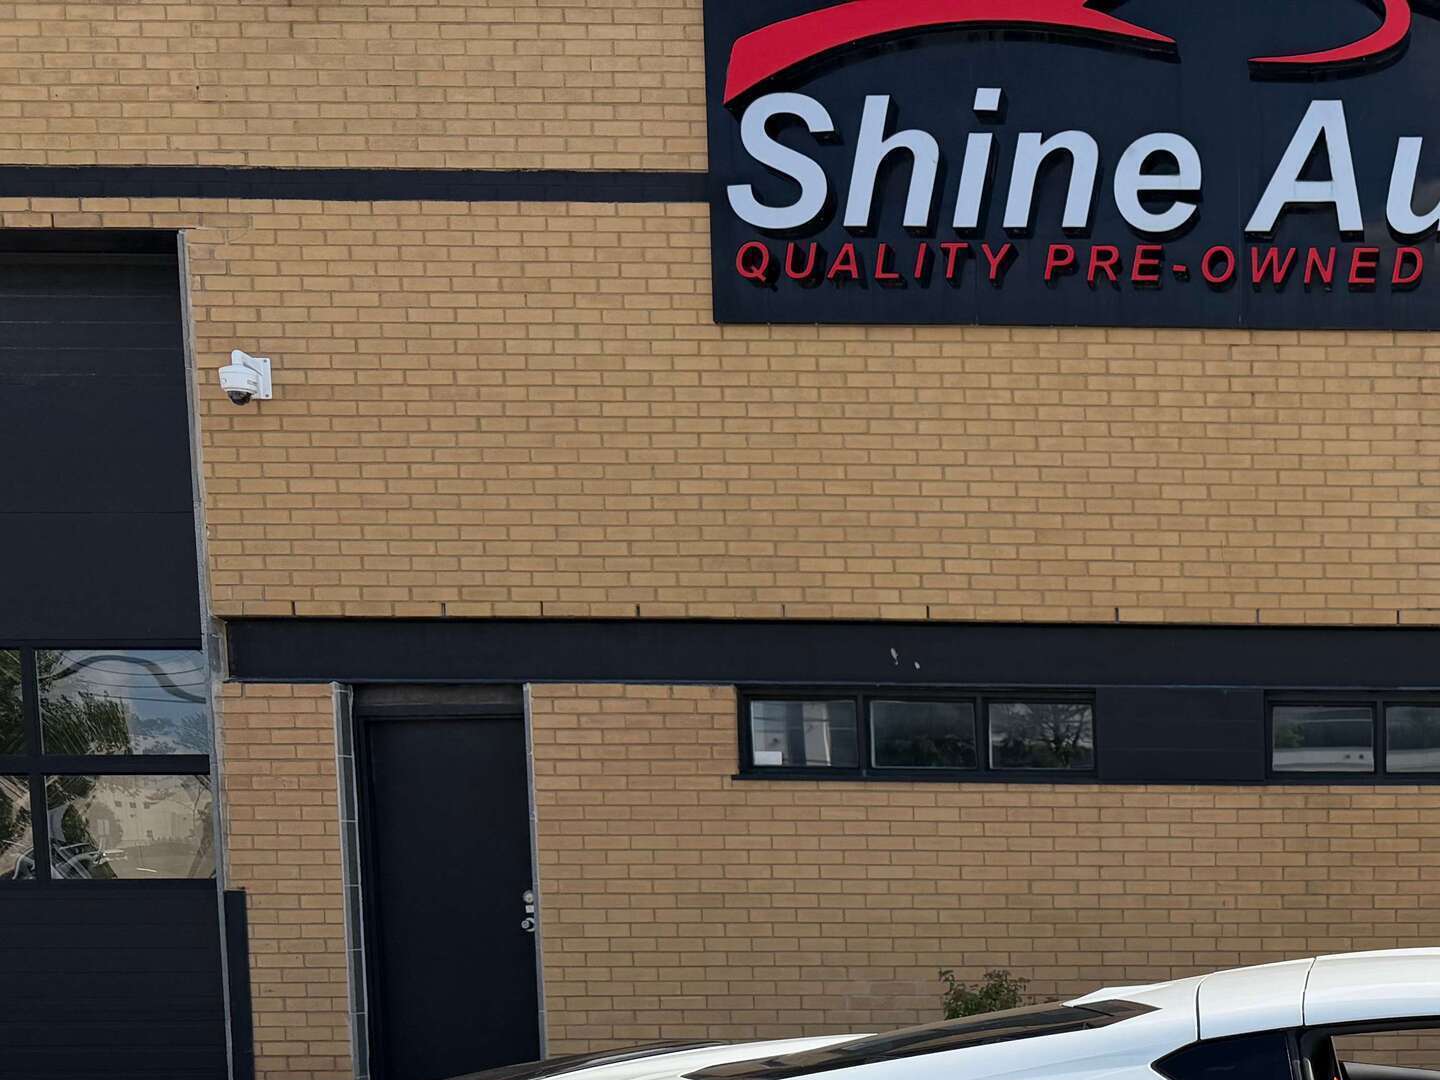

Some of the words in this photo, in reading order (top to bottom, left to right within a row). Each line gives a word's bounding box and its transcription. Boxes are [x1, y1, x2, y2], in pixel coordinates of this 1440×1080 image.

[727, 87, 1202, 232] Shine
[736, 241, 1011, 281] QUALITY
[1044, 244, 1424, 285] PRE-OWNED
